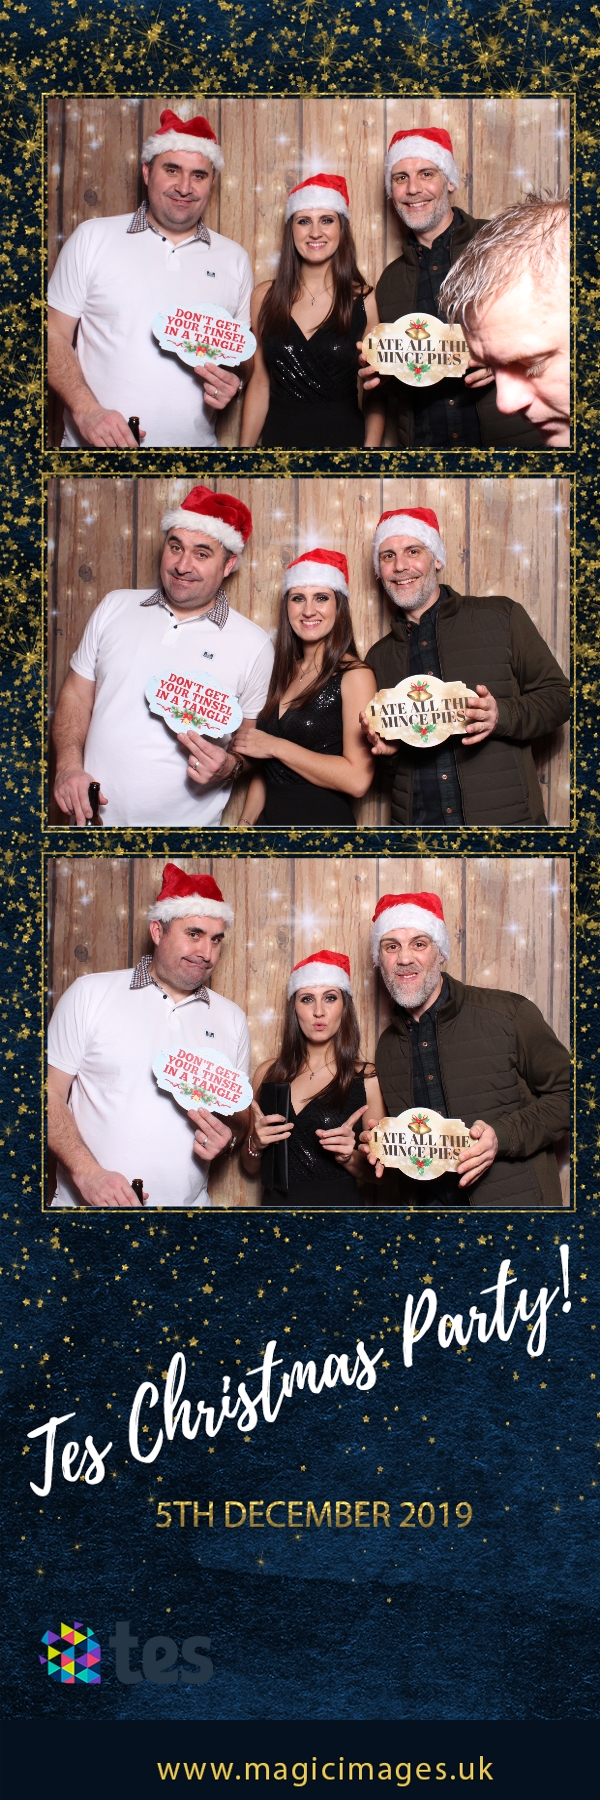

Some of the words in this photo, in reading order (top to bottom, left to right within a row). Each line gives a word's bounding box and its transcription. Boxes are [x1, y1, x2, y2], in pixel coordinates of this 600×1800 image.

[168, 316, 199, 332] YOUR
[203, 326, 246, 344] TINSEL
[175, 308, 213, 325] DON'T
[216, 319, 240, 332] GET
[164, 326, 179, 336] IN
[181, 331, 190, 339] A
[194, 333, 245, 353] TANGLE
[368, 338, 372, 349] I
[376, 339, 403, 350] ATE
[407, 340, 435, 351] ALL
[377, 351, 423, 364] MINCE
[428, 353, 461, 365] PIES
[160, 680, 189, 698] YOUR
[193, 692, 232, 716] TINSEL
[168, 673, 204, 693] DON'T
[205, 688, 229, 703] GET
[156, 689, 170, 700] IN
[170, 696, 178, 705] A
[183, 700, 230, 725] TANGLE
[371, 706, 375, 716] I
[380, 703, 407, 716] ATE
[411, 700, 438, 713] ALL
[381, 714, 428, 728] MINCE
[432, 710, 466, 724] PIES
[168, 1055, 199, 1075] YOUR
[202, 1070, 243, 1094] TINSEL
[177, 1049, 214, 1070] DON'T
[216, 1066, 240, 1081] GET
[163, 1064, 179, 1076] IN
[179, 1072, 188, 1082] A
[192, 1077, 241, 1103] TANGLE
[374, 1132, 377, 1142] I
[381, 1132, 406, 1144] ATE
[410, 1134, 436, 1146] ALL
[440, 1135, 470, 1148] THE
[382, 1145, 425, 1158] MINCE
[429, 1147, 460, 1160] PIES
